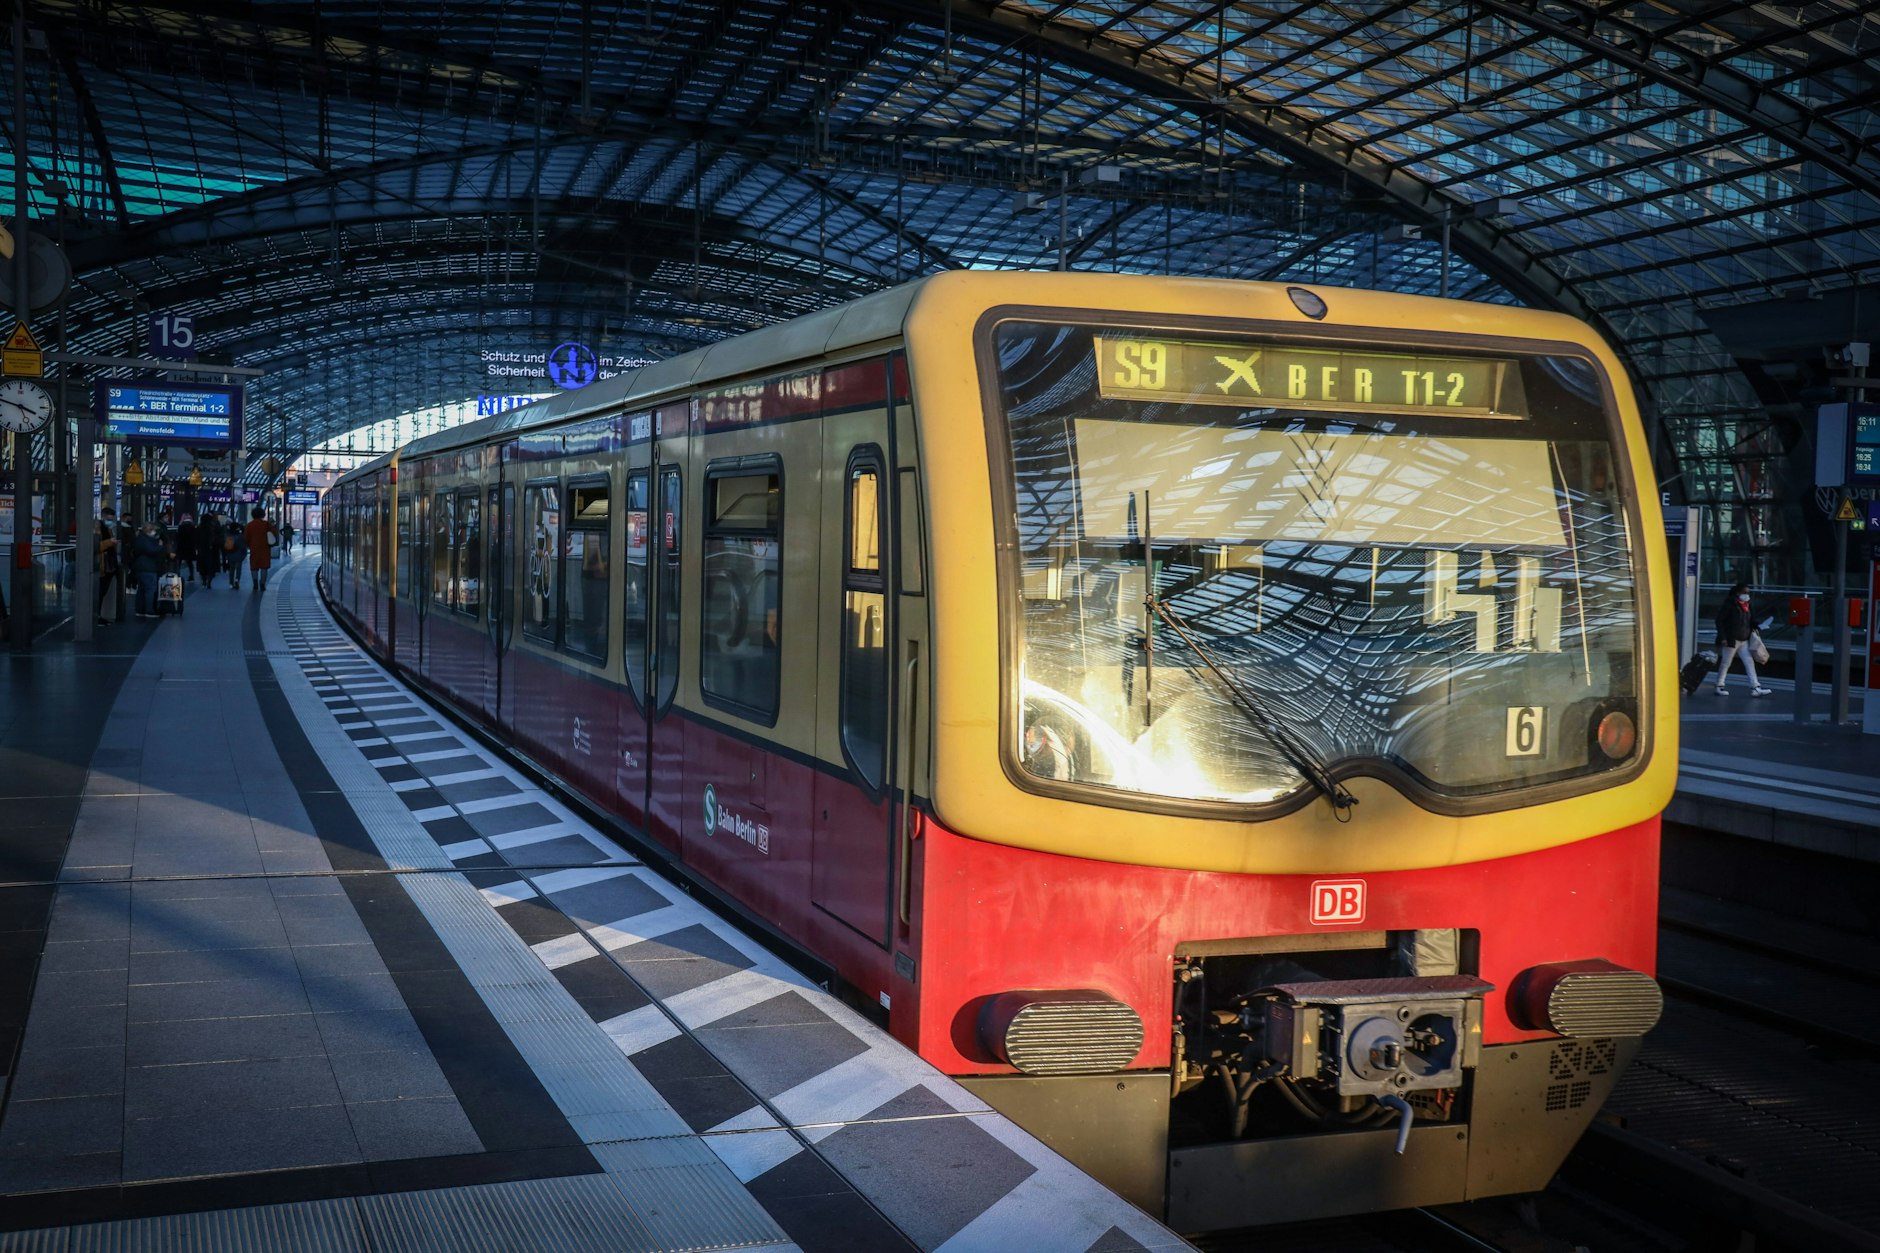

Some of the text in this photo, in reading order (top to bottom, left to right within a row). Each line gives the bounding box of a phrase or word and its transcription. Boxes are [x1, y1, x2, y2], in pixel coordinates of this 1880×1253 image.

[154, 316, 194, 348] 15
[481, 349, 546, 364] Schutz und
[599, 355, 613, 367] im
[487, 364, 546, 378] Sicherheit
[1114, 341, 1166, 390] S9
[1401, 370, 1464, 407] T1-2
[110, 388, 122, 397] S9
[150, 401, 225, 413] BER Terminal 1-2
[1661, 492, 1671, 506] E
[1516, 707, 1536, 752] 6
[718, 804, 735, 834] Bahn
[736, 814, 757, 846] Berlin
[1318, 887, 1358, 917] DB
